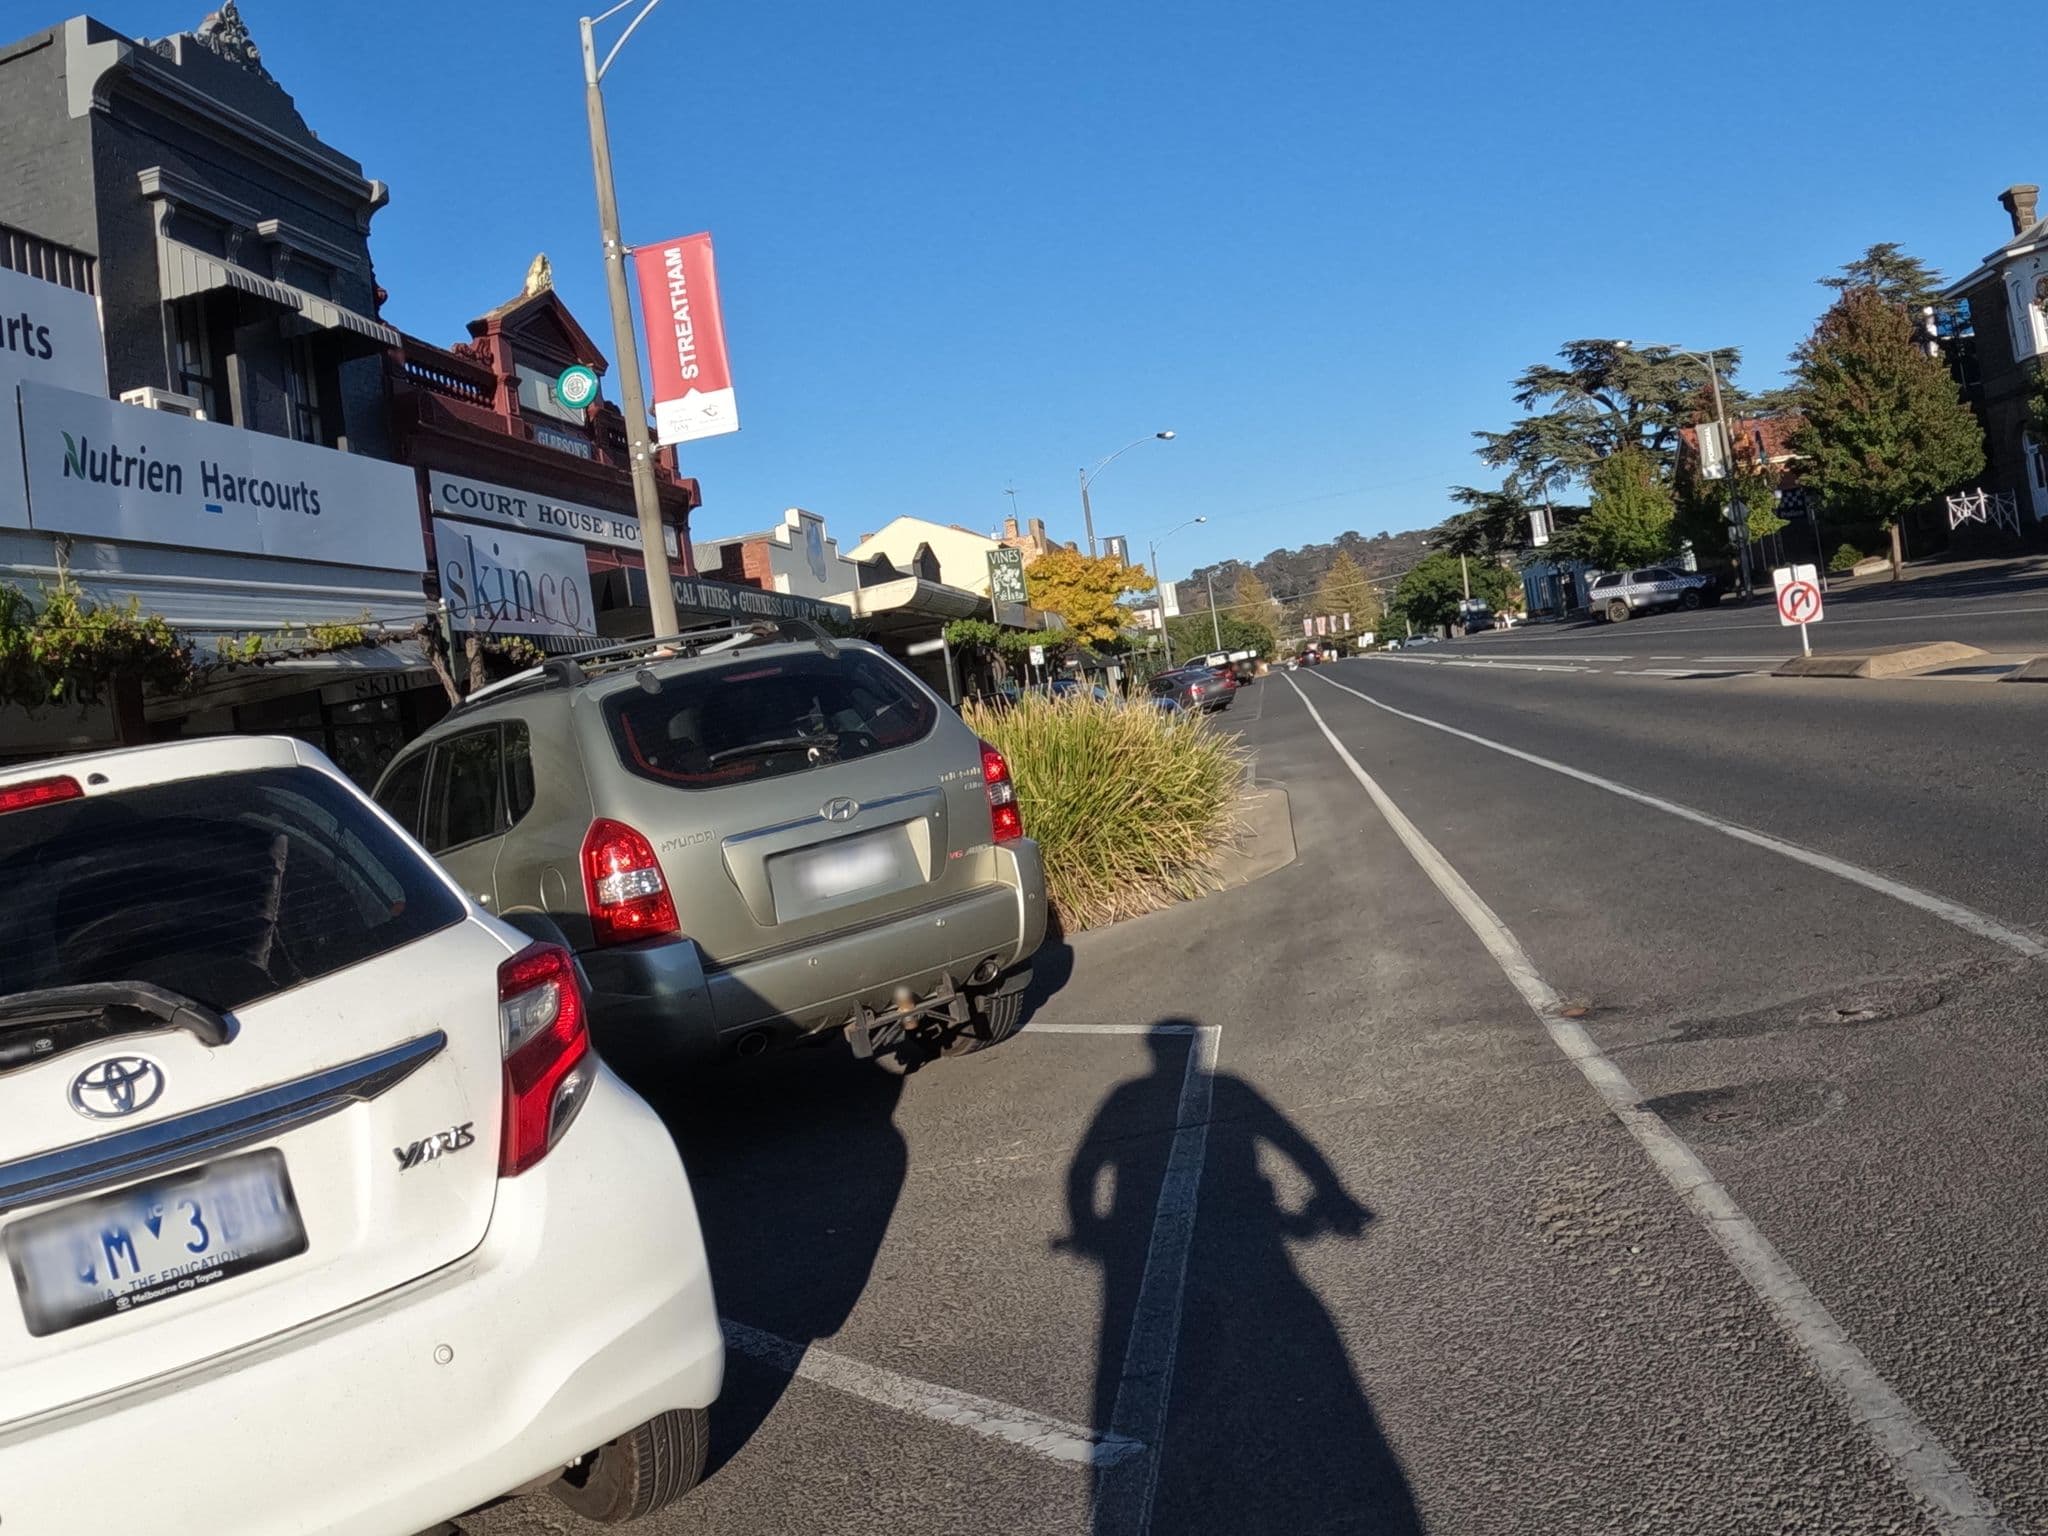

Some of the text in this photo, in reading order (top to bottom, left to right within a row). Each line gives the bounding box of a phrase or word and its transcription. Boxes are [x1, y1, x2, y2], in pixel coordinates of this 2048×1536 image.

[664, 247, 699, 380] STREATHAM
[61, 430, 321, 516] Nutrien Harcourts
[442, 483, 528, 518] COURT
[538, 504, 604, 534] HOUSE
[989, 550, 1020, 564] VINES
[698, 584, 732, 610] WINES
[739, 590, 783, 617] GUINNESS
[783, 600, 795, 618] ON
[662, 829, 717, 853] HYUNDAI
[392, 1121, 475, 1172] YARIS
[129, 1271, 158, 1294] THE
[162, 1248, 242, 1281] EDUCATION
[131, 1283, 179, 1304] Melbourne
[178, 1273, 196, 1291] City
[195, 1270, 223, 1285] Toyota
